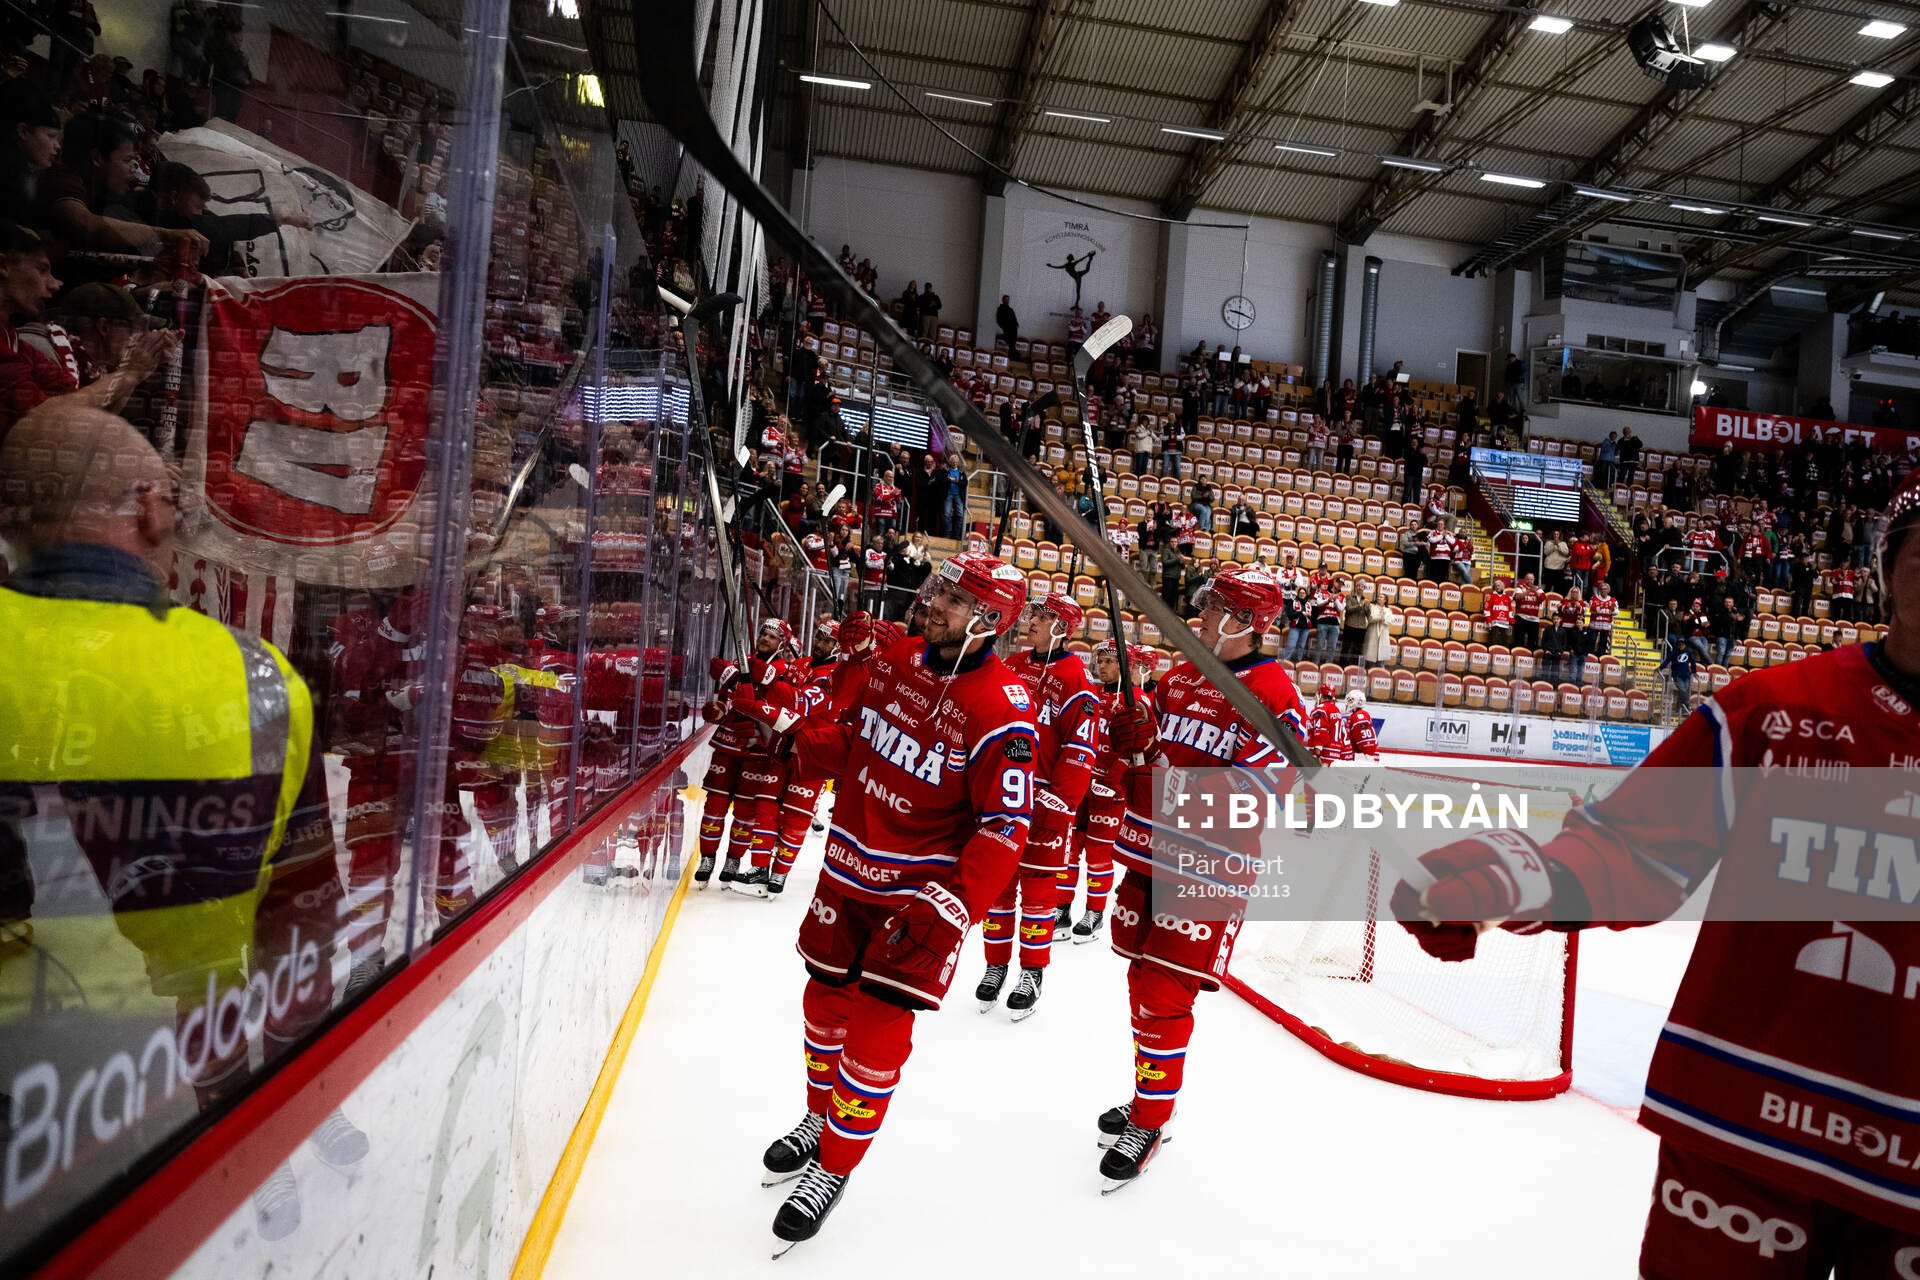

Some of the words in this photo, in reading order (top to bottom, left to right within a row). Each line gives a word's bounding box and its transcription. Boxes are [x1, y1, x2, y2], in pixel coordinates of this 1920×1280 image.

[1064, 221, 1089, 231] TIMRÅ
[877, 660, 892, 676] SCA
[804, 685, 825, 706] 23
[898, 711, 919, 728] NHC
[1199, 706, 1219, 718] NHC
[1161, 712, 1238, 761] IMRÅ
[1360, 729, 1372, 739] 30
[1798, 718, 1856, 744] SCA
[1244, 733, 1290, 785] 72
[1785, 754, 1851, 783] LILIUM
[787, 784, 815, 798] coop
[864, 778, 912, 814] NHC
[828, 843, 902, 883] BILBOLAGET
[1154, 912, 1212, 942] coop
[1661, 1178, 1807, 1259] coop
